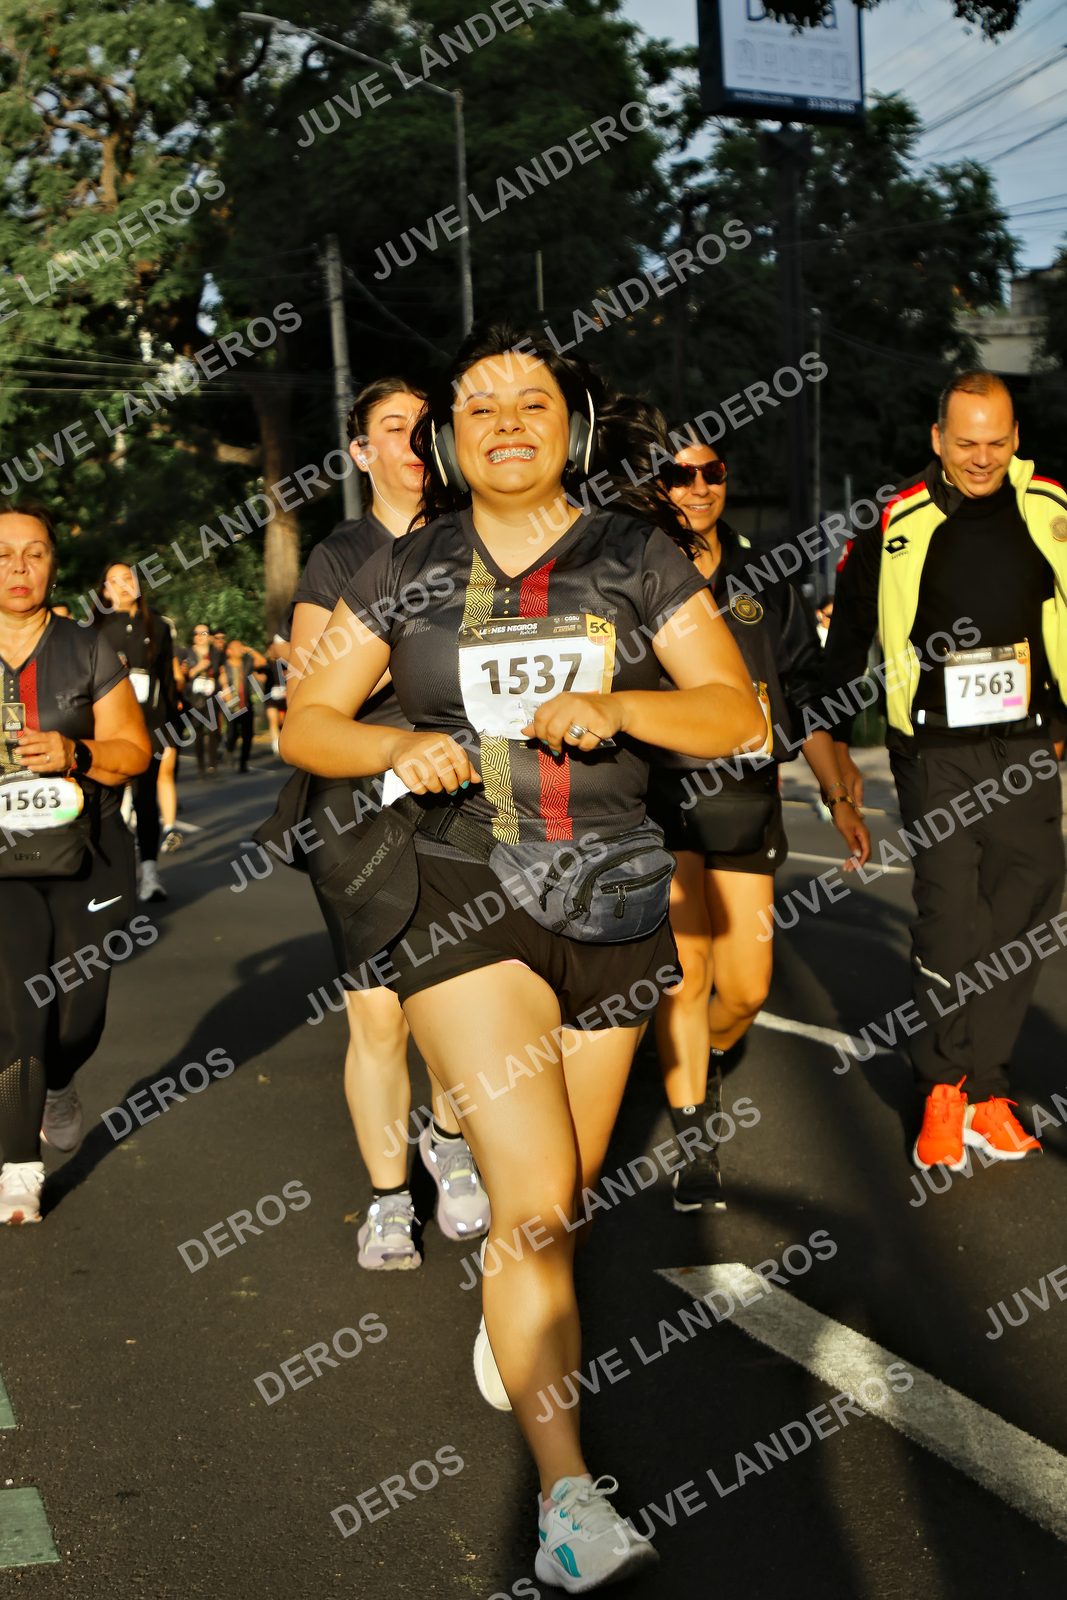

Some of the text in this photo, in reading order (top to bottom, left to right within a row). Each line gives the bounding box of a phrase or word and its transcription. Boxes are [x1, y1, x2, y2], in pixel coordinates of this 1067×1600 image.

[506, 622, 538, 632] NEGROS
[590, 622, 608, 634] 5K
[480, 653, 582, 694] 1537
[958, 670, 1014, 698] 7563
[1, 786, 61, 811] 1563
[344, 842, 390, 896] RUN SPORT
